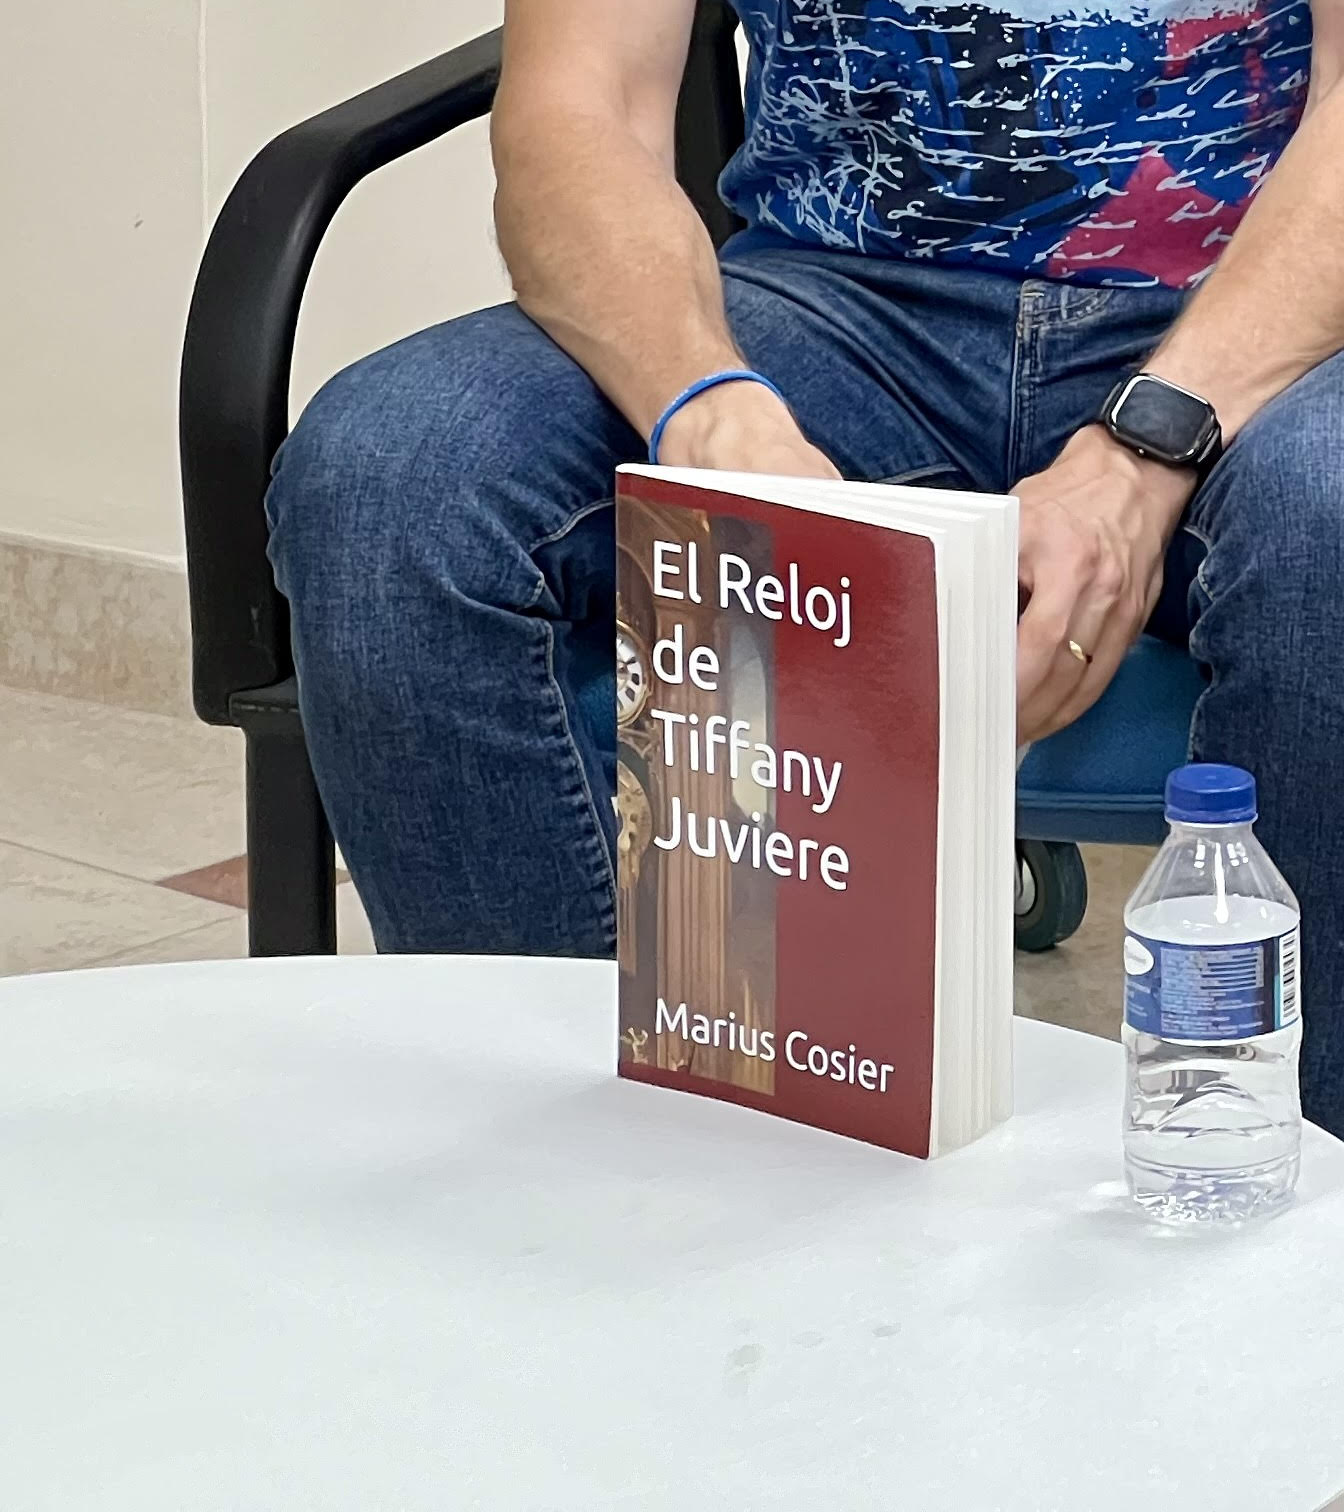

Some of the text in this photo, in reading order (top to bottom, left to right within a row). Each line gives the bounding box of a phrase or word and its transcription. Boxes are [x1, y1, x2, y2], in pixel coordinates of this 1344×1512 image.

[653, 539, 852, 648] El Reloj
[652, 623, 720, 691] de
[650, 708, 843, 815] Tiffany
[652, 795, 850, 891] Juviere
[654, 997, 895, 1093] Marius Cosier
